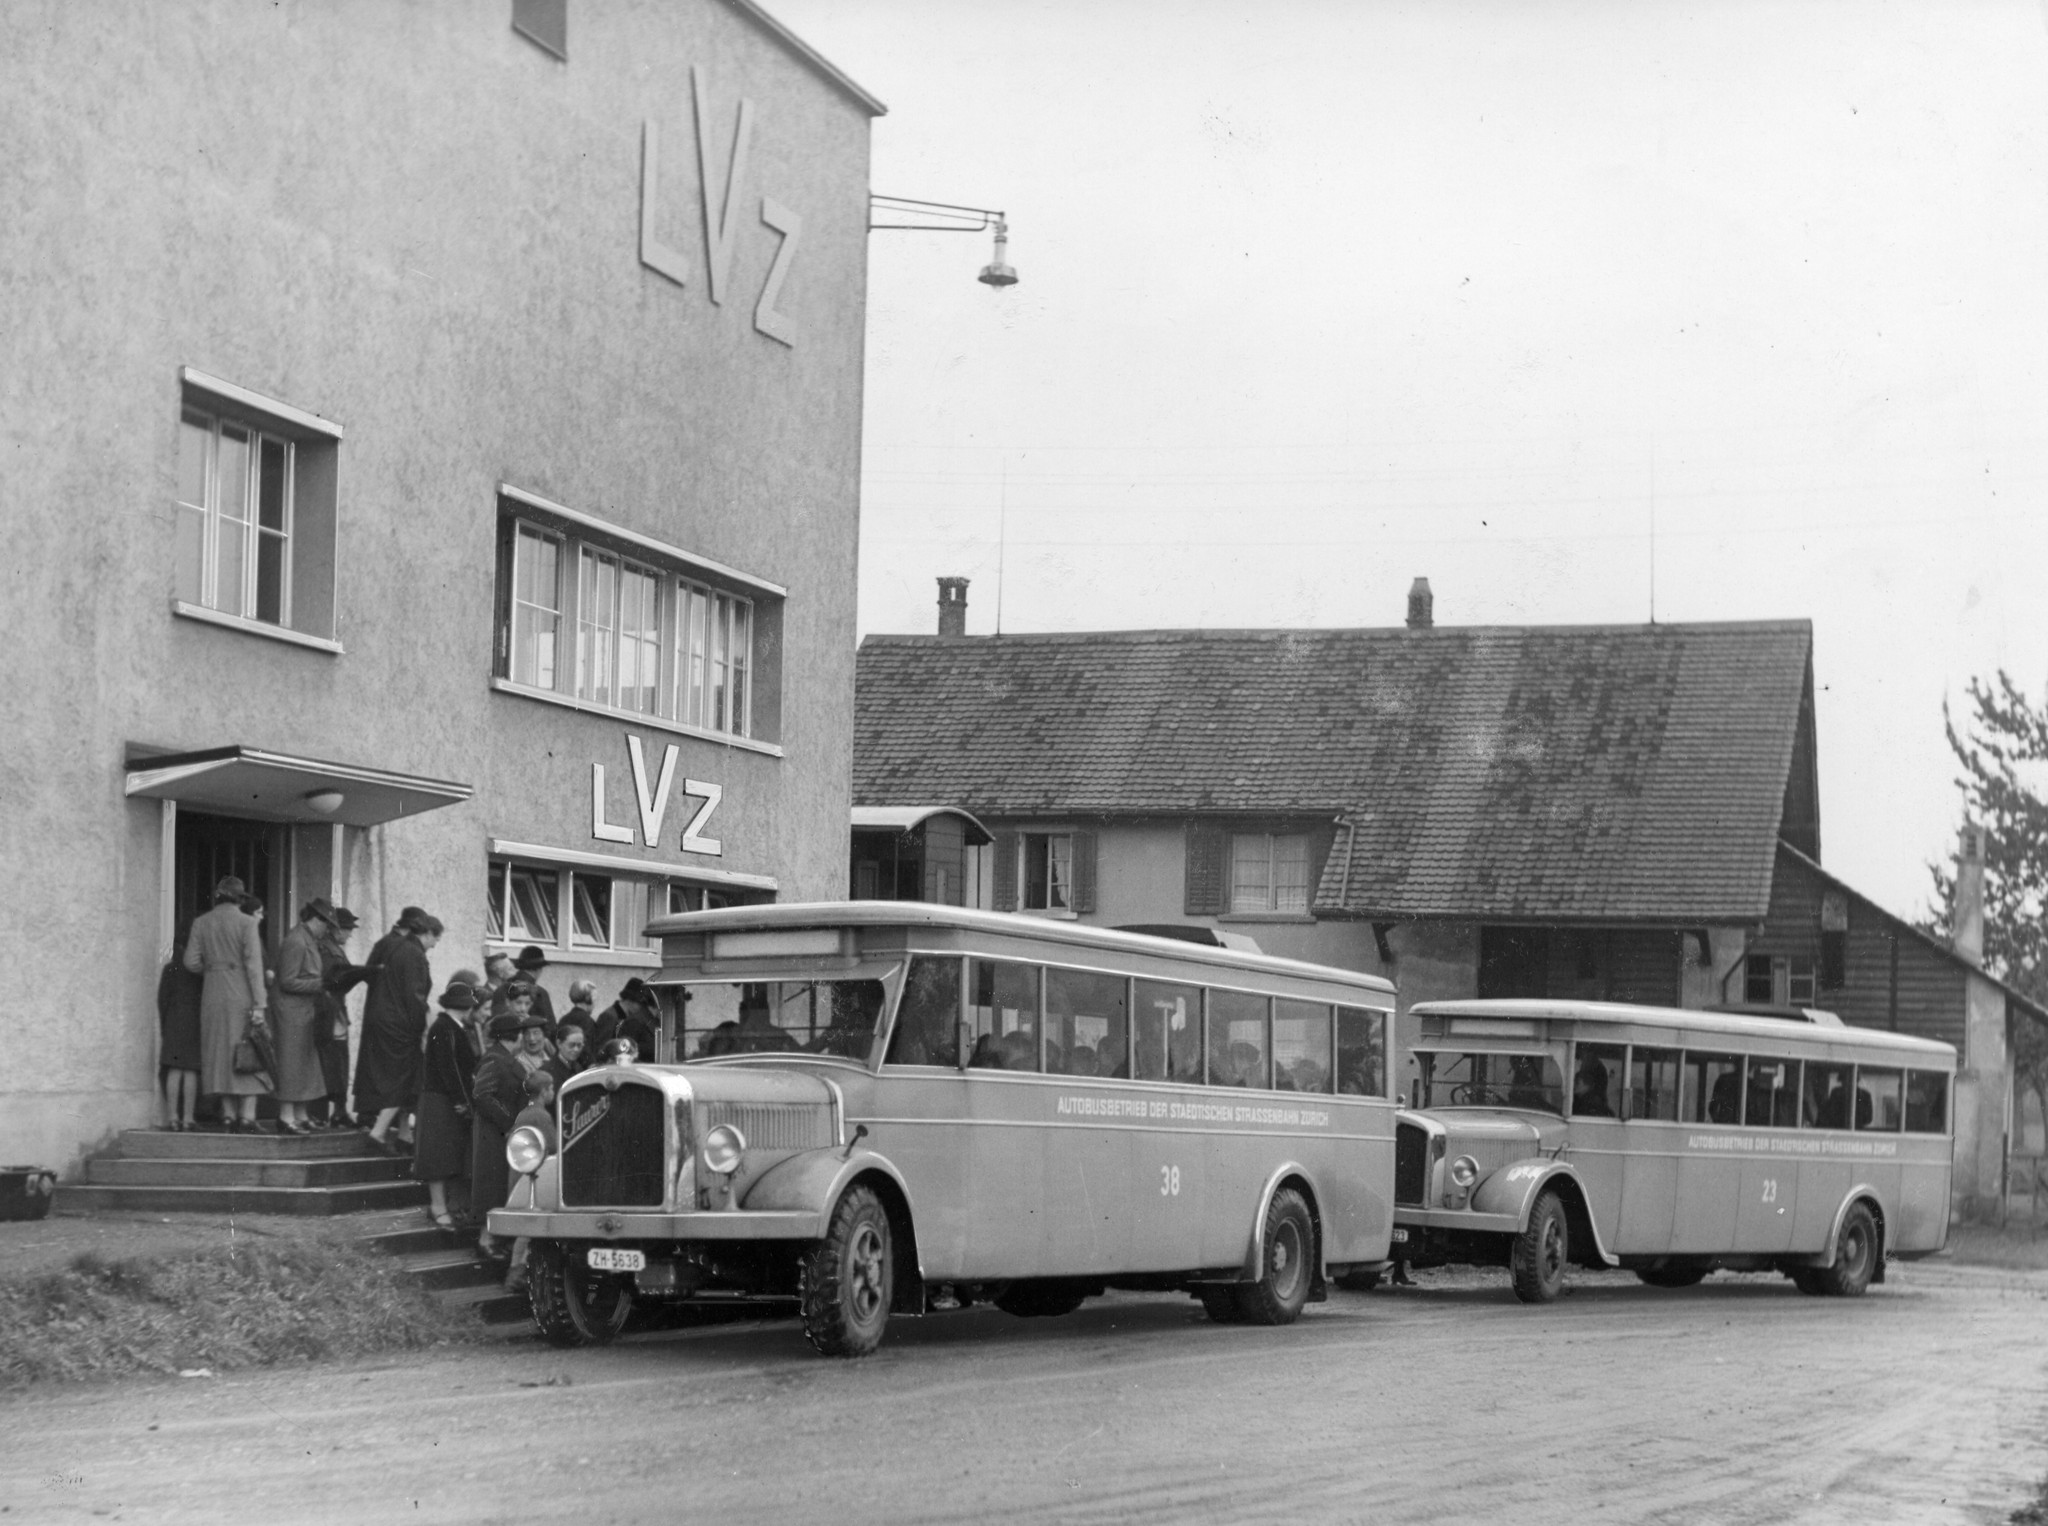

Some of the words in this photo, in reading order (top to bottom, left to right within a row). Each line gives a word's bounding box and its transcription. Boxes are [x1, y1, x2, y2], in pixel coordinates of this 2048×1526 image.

[639, 64, 802, 350] LVZ
[592, 732, 723, 857] LVZ
[1057, 1096, 1147, 1118] AUTOBUSBETRIEB
[1149, 1101, 1168, 1118] DER
[1170, 1103, 1233, 1122] STAEDTISCHEN
[1235, 1106, 1299, 1125] STRASSENBAHN
[1160, 1165, 1180, 1196] 38
[1762, 1179, 1777, 1203] 23
